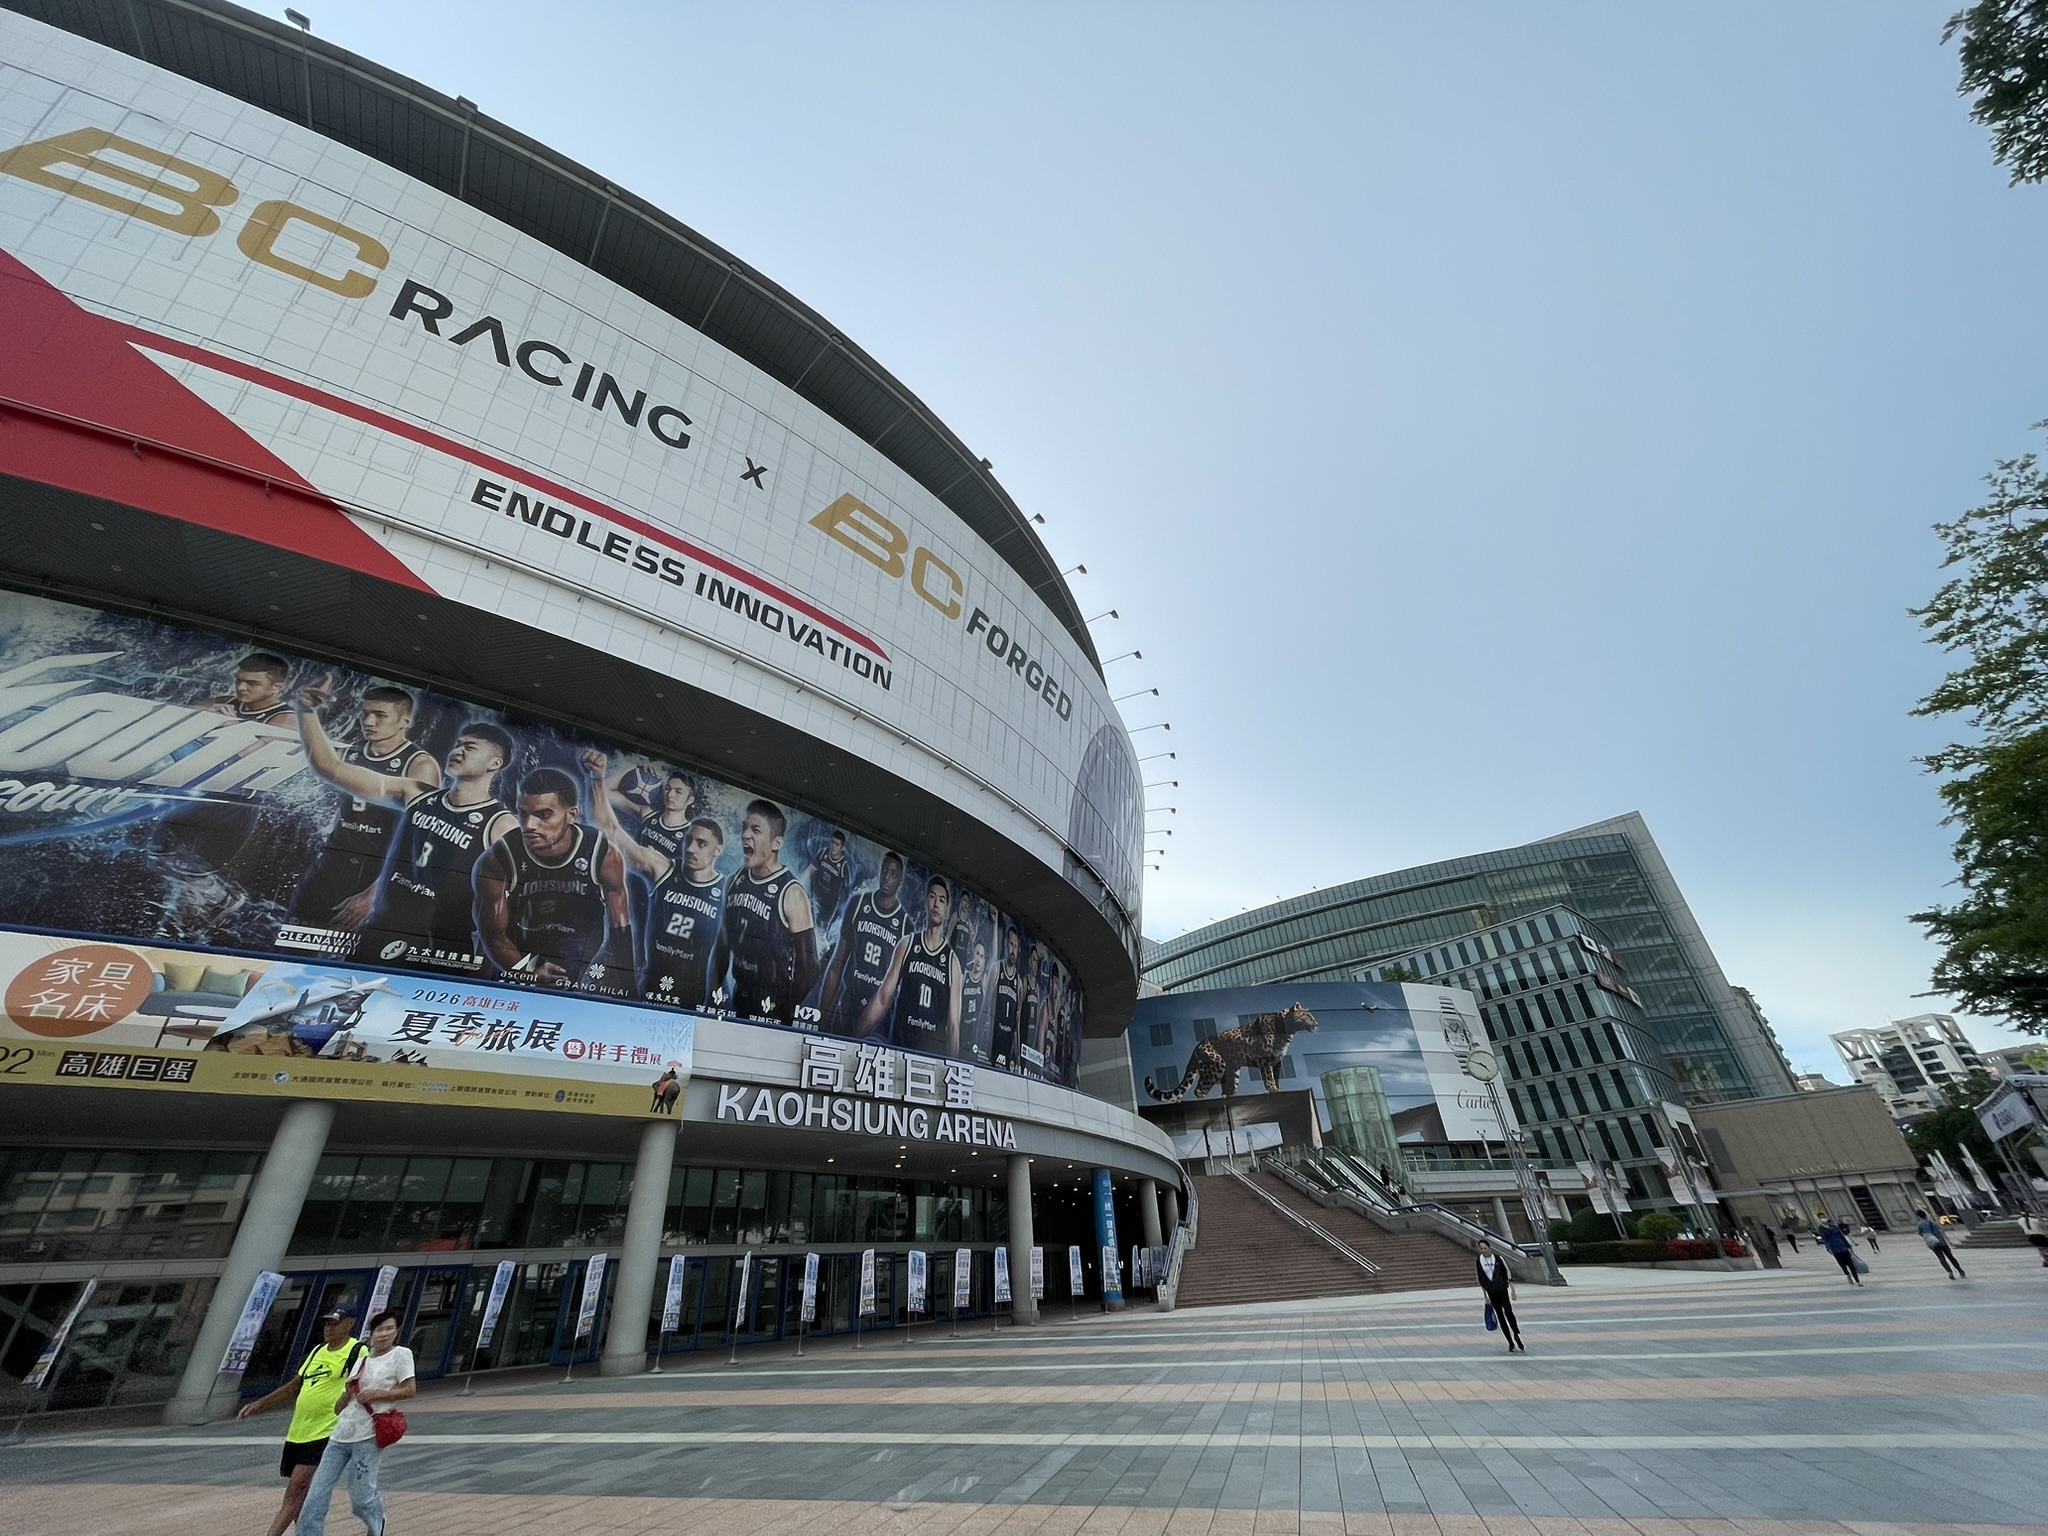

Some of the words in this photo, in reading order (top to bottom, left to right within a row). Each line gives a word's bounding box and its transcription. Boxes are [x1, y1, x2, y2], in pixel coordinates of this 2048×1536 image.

[0, 127, 388, 299] BC
[389, 279, 693, 450] RACING
[808, 492, 963, 621] BC
[966, 607, 1072, 722] FORGED
[471, 478, 686, 588] ENDLESS
[694, 572, 892, 691] INNOVATION
[663, 890, 718, 919] KAOHSIUNG
[666, 913, 695, 939] 22
[857, 920, 898, 946] KAOHSIUNG
[278, 931, 360, 949] CLEANAWAY
[407, 945, 484, 965] 九太科技集團
[864, 941, 882, 967] 92
[41, 957, 134, 991] 家具
[500, 969, 538, 983] ascent
[909, 960, 946, 985] KAOHSIUNG
[555, 978, 596, 993] GRAND
[599, 983, 629, 997] HILAI
[919, 983, 932, 1008] 10
[21, 988, 122, 1021] 名床
[411, 989, 461, 1005] 2026
[462, 995, 520, 1013] 高雄巨蛋
[387, 1009, 565, 1053] 夏季旅展
[907, 1015, 936, 1032] FamilyMart
[60, 1053, 194, 1082] 高雄巨蛋
[801, 1036, 976, 1111] 高雄巨蛋
[716, 1084, 928, 1139] KAOHSIUNG
[935, 1112, 1018, 1149] ARENA
